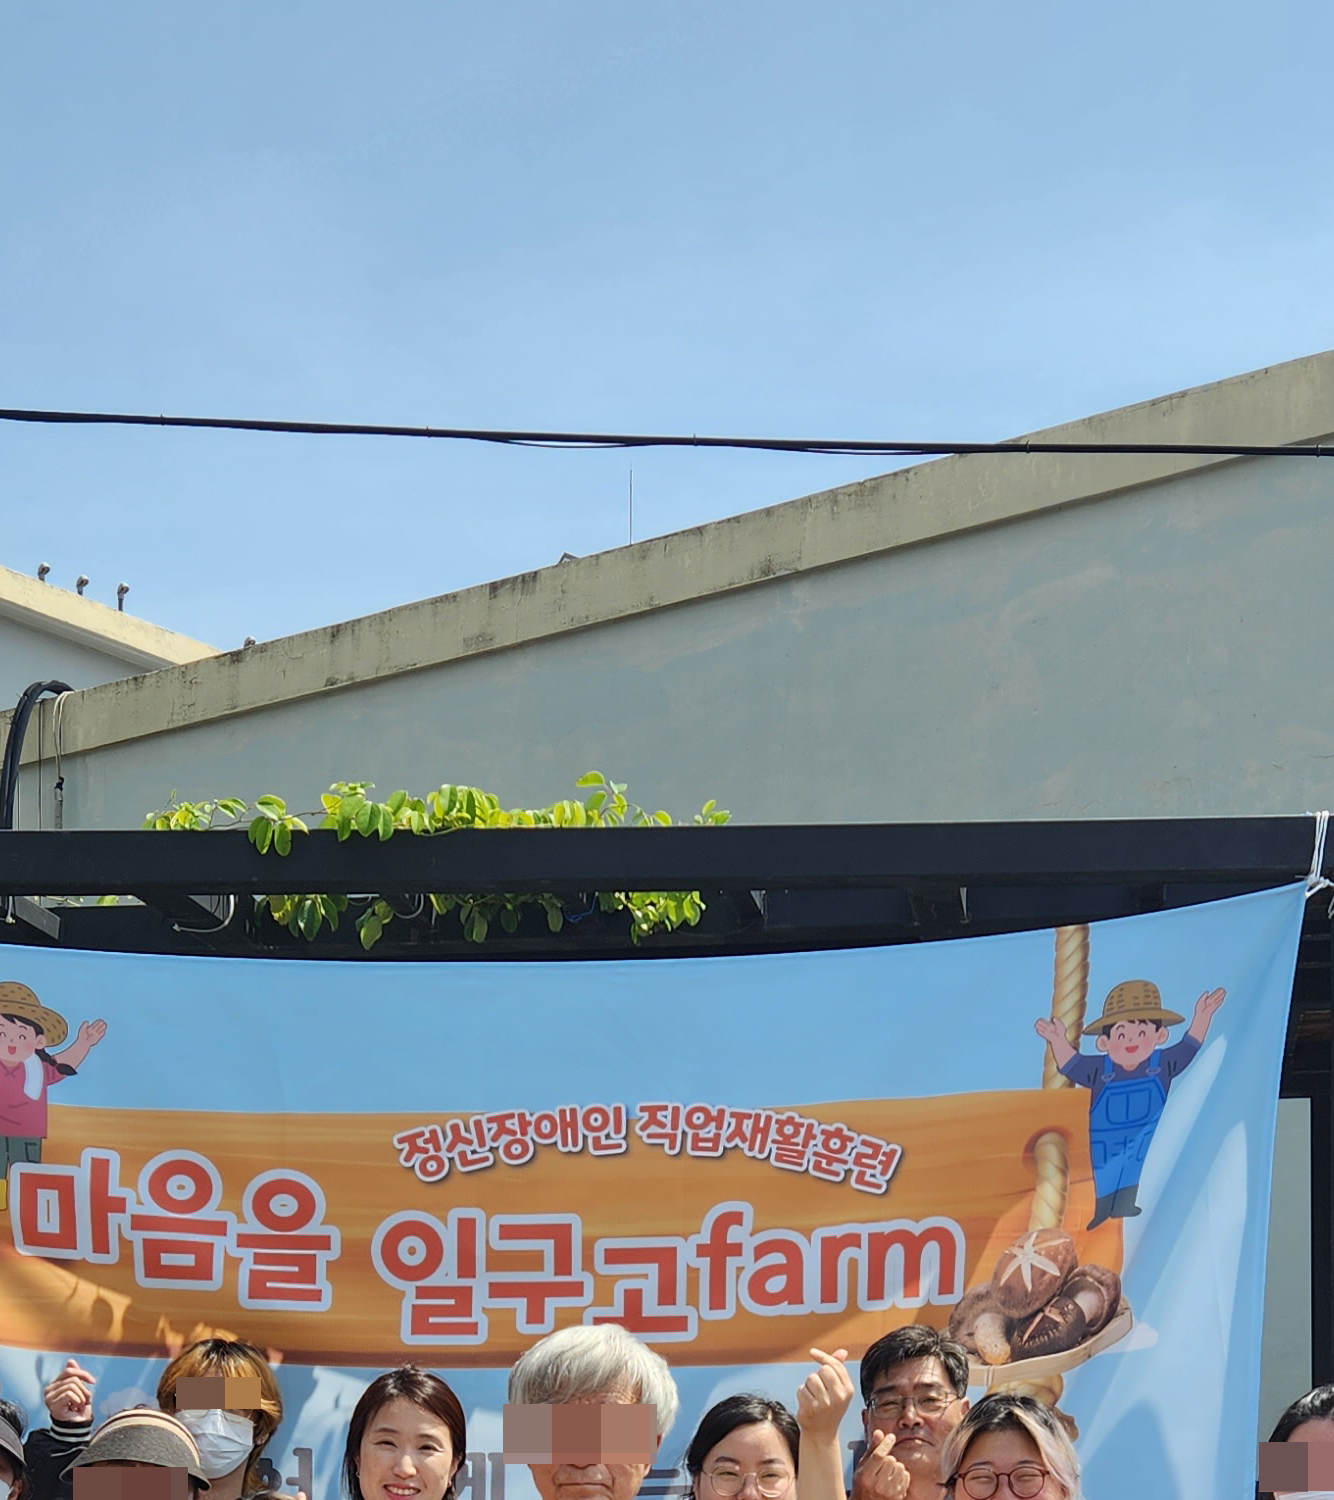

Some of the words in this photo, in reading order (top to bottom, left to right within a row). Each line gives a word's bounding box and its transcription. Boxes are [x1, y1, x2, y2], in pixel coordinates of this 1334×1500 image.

[396, 1104, 625, 1180] 정신장애인
[638, 1104, 900, 1192] 직업재활훈련
[14, 1151, 338, 1308] 마음을
